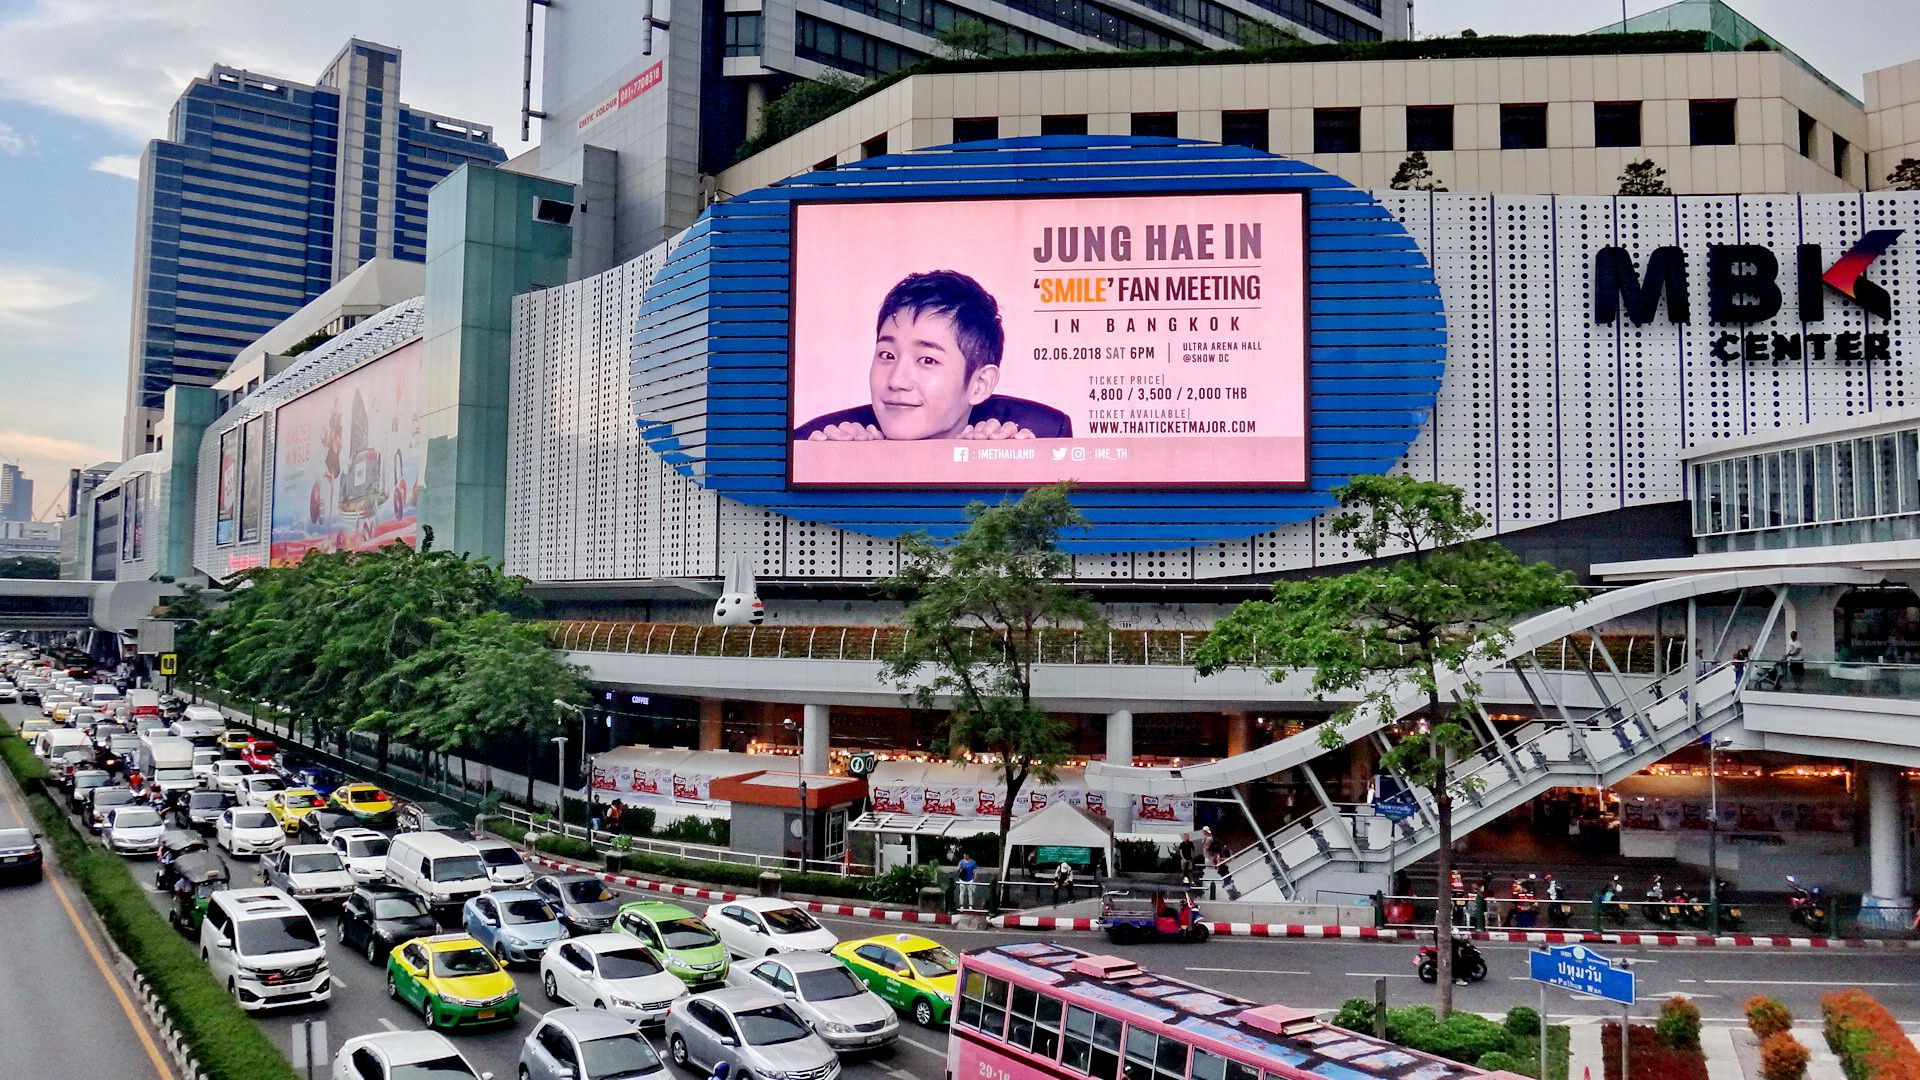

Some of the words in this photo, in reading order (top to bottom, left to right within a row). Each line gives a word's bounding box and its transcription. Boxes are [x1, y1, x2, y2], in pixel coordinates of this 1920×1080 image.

[1033, 225, 1132, 264] JUNG
[1145, 224, 1215, 261] HAE
[1224, 222, 1262, 260] IN
[1593, 228, 1907, 325] MBK
[1118, 276, 1160, 302] FAN
[1166, 274, 1262, 301] MEETING
[1053, 318, 1081, 334] IN
[1106, 316, 1241, 333] BANGKOK
[1033, 346, 1102, 361] 02.06.2018
[1105, 346, 1126, 360] SAT
[1129, 346, 1156, 360] 6PM
[1182, 341, 1208, 351] ULTRA
[1210, 341, 1239, 351] ARENA
[1241, 341, 1263, 351] HALL
[1713, 333, 1893, 361] CENTER
[1182, 353, 1216, 363] @SHOW
[1218, 353, 1230, 363] DC
[1089, 375, 1125, 386] TICKET
[1130, 375, 1161, 386] PRICE
[1089, 388, 1123, 402] 4,800
[1137, 387, 1173, 401] 3,500
[1186, 387, 1222, 401] 2,000
[1225, 387, 1248, 400] THB
[1089, 409, 1125, 420] TICKET
[1129, 409, 1187, 420] AVAILABLE
[1088, 420, 1257, 434] WWW.THAITICKETMAJOR.COM
[631, 696, 649, 705] COFFEE
[1557, 961, 1603, 984] ปทุมวัน
